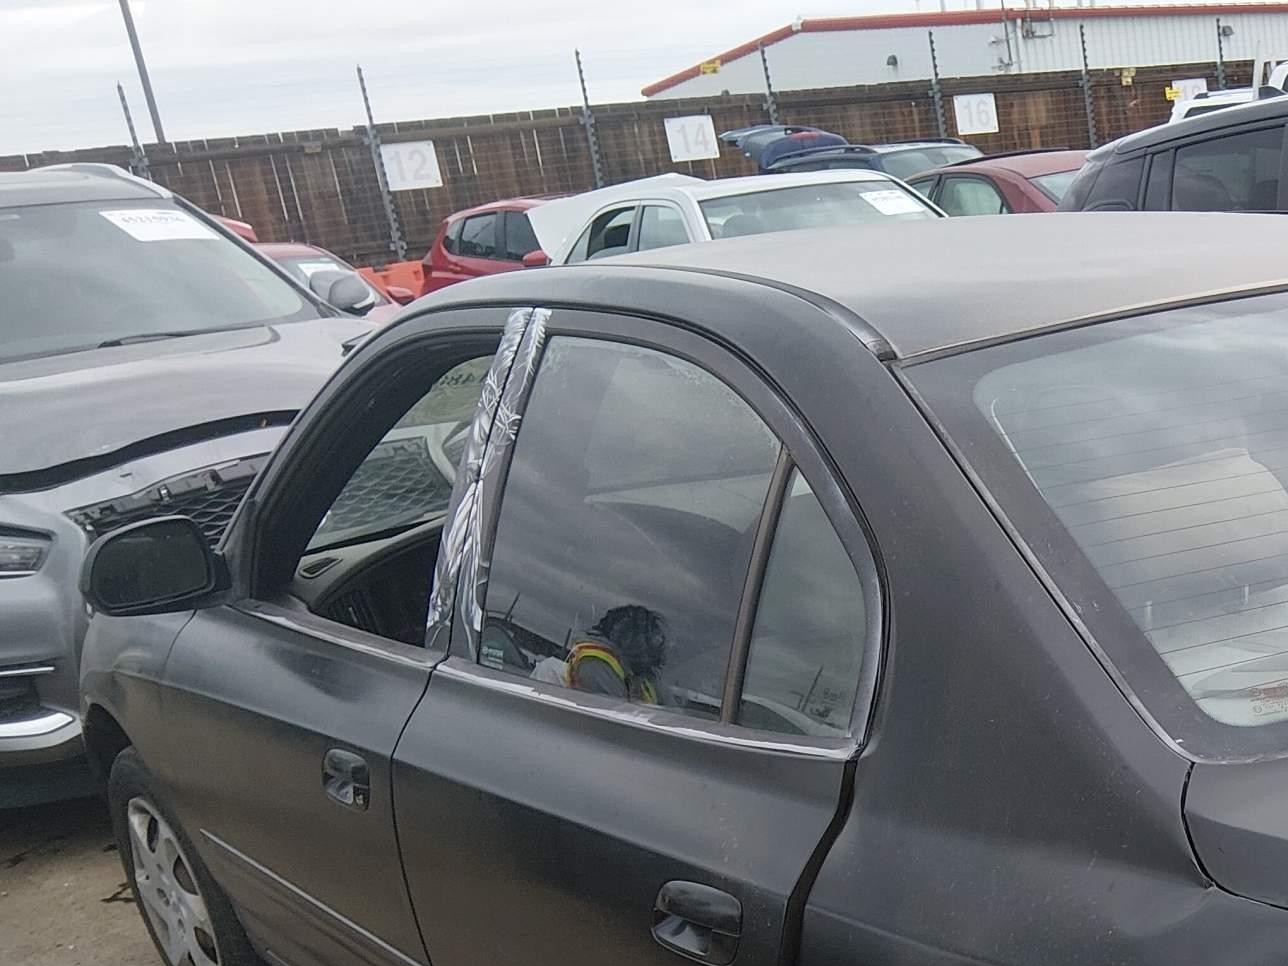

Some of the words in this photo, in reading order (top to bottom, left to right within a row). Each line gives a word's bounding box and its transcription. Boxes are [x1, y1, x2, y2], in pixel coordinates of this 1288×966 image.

[963, 99, 991, 128] 16
[675, 122, 709, 153] 14
[388, 149, 432, 182] 12
